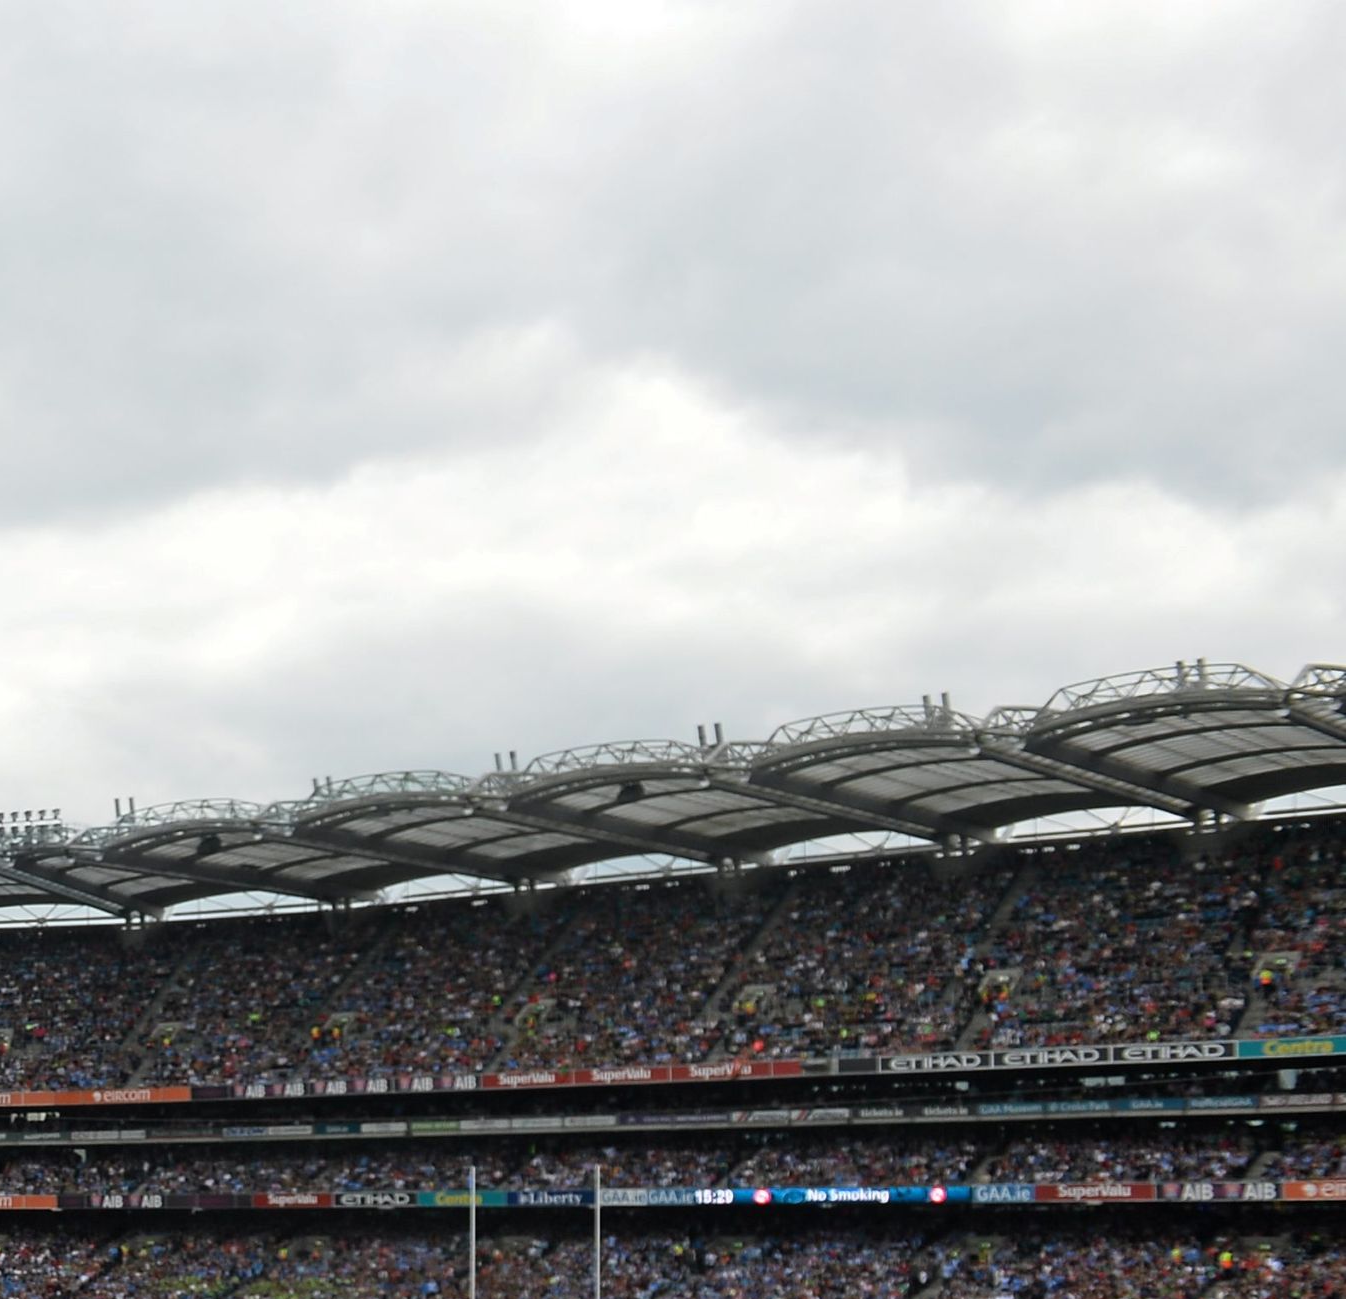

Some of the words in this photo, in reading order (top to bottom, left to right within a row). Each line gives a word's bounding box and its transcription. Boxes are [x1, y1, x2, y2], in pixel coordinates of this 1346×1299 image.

[1123, 1044, 1225, 1059] ETIHAD
[1262, 1039, 1334, 1056] Centra
[890, 1054, 981, 1071] ETIHAD
[1003, 1049, 1100, 1066] ETIHAD
[454, 1075, 476, 1088] AIB
[499, 1072, 555, 1088] SuperValu
[592, 1067, 651, 1084] SuperValu
[284, 1084, 305, 1096] AIB
[327, 1081, 347, 1093] AIB
[367, 1079, 388, 1092] AIB
[412, 1077, 433, 1090] AIB
[104, 1089, 150, 1102] eircom
[245, 1086, 266, 1098] AIB
[807, 1190, 827, 1201] No
[829, 1189, 890, 1204] Smoking
[977, 1189, 1031, 1203] GAA.ie
[1058, 1183, 1131, 1200] SuperValu
[1182, 1184, 1214, 1200] AIB
[1242, 1183, 1277, 1199] AIB
[103, 1196, 123, 1208] AIB
[141, 1195, 162, 1208] AIB
[267, 1194, 318, 1207] SuperValu
[341, 1193, 410, 1205] ETIHAD
[436, 1192, 482, 1206] Centa
